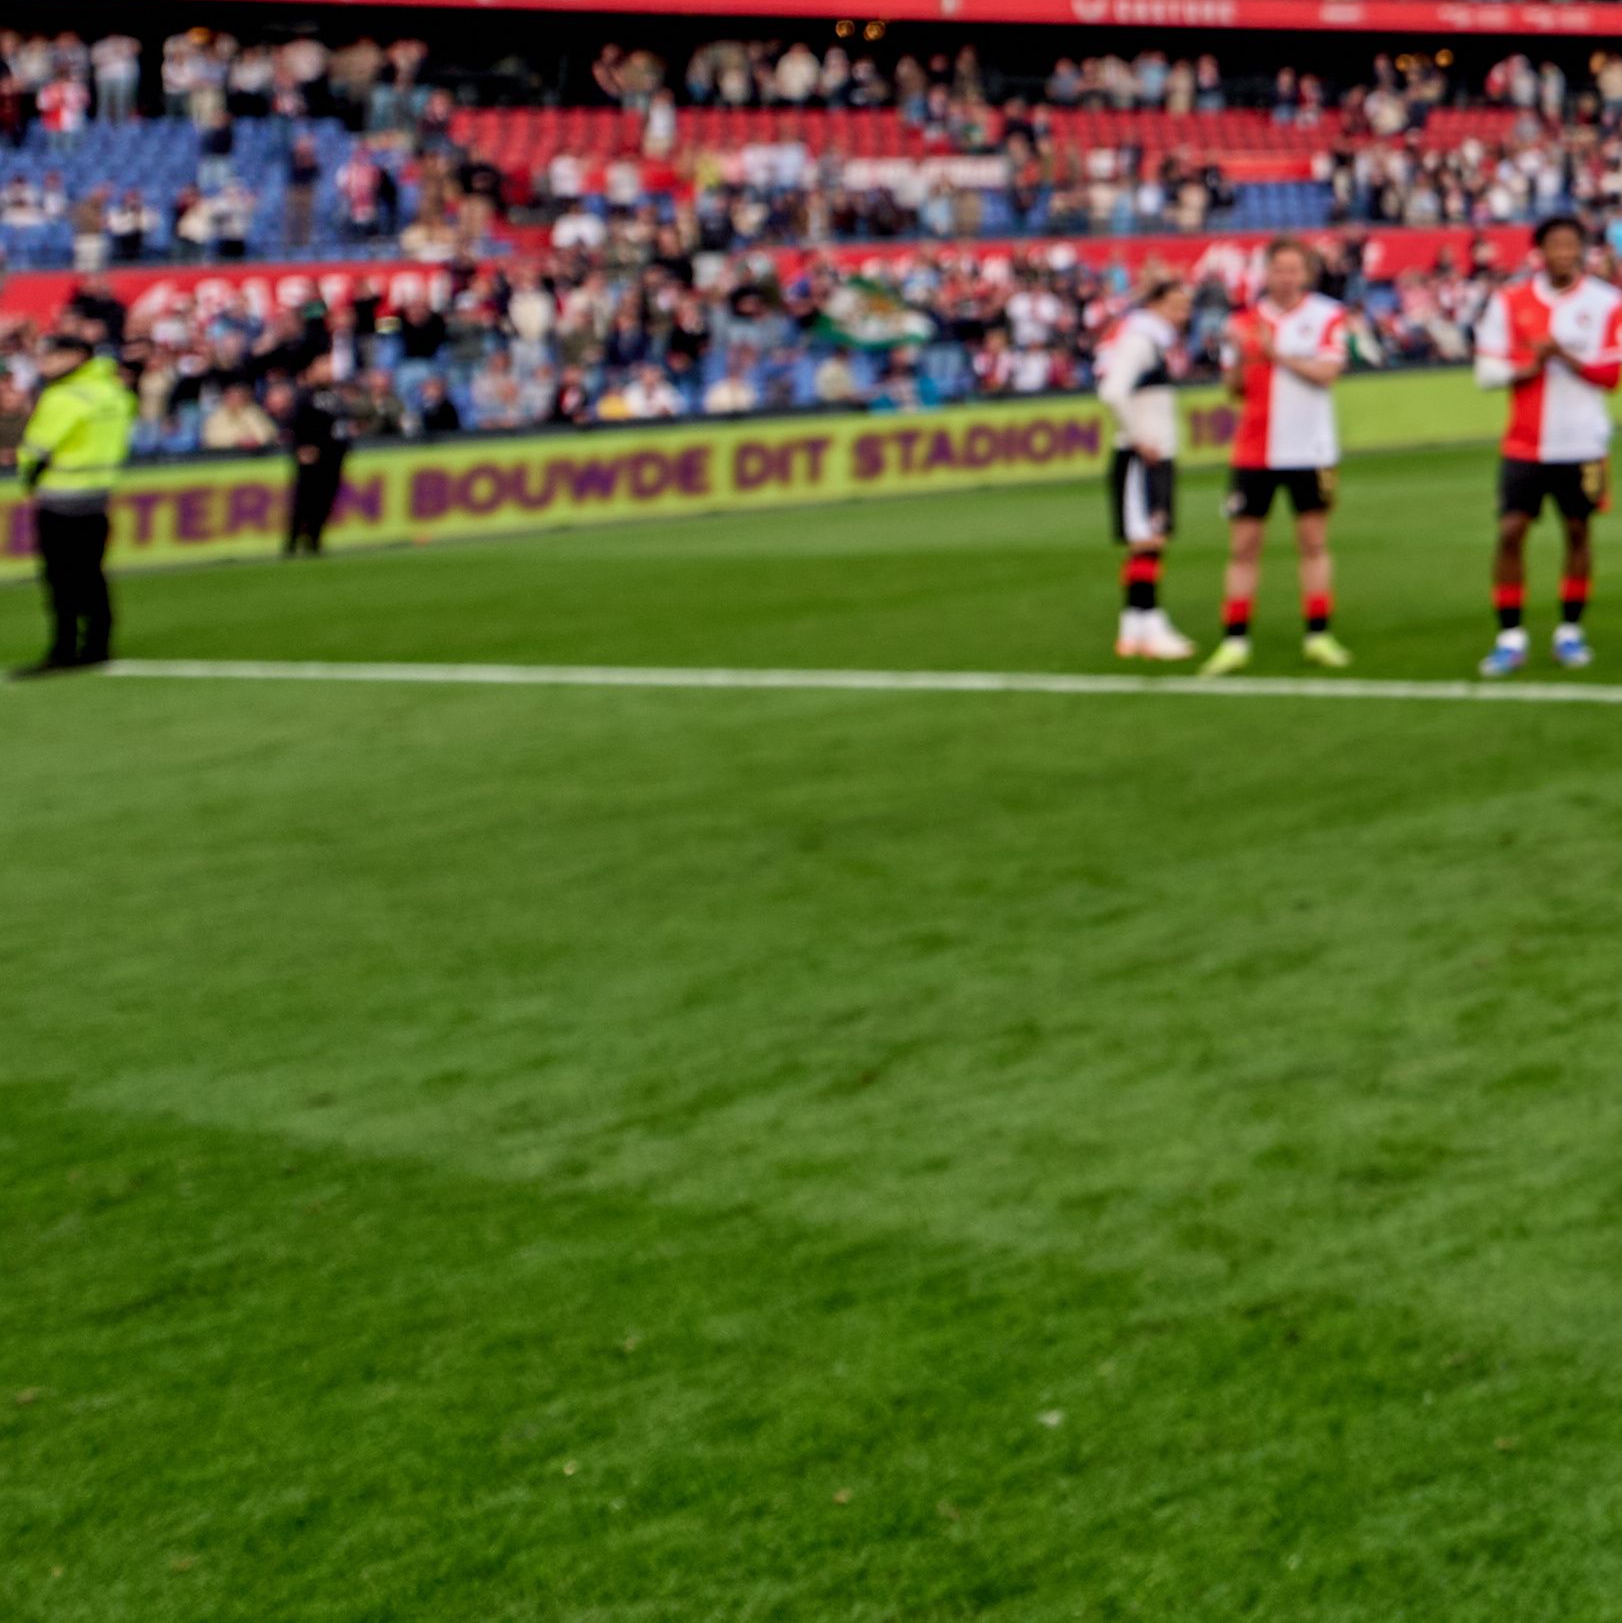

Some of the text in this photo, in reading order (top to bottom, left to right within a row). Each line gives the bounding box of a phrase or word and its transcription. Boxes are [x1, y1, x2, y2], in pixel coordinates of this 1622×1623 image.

[408, 441, 711, 523] BOUWDE
[734, 436, 832, 491] DIT
[851, 415, 1102, 481] STADION
